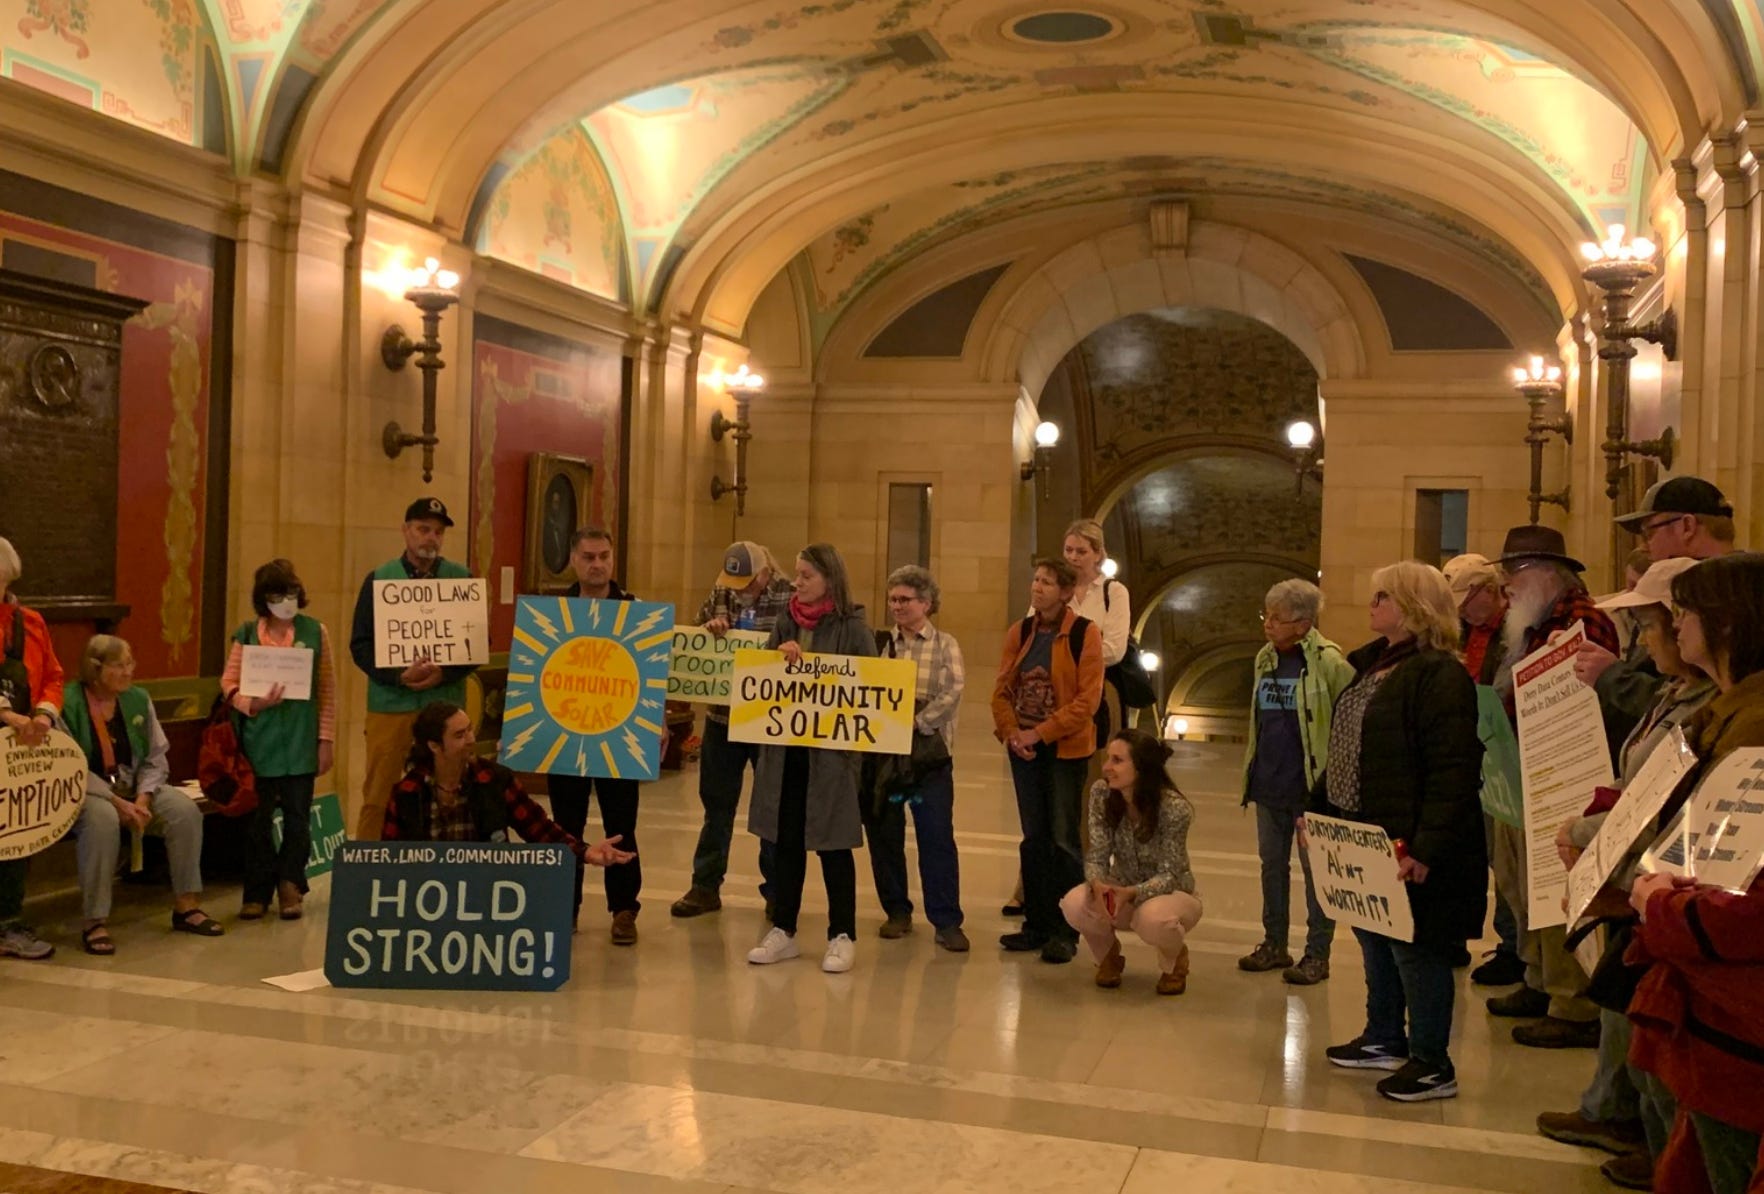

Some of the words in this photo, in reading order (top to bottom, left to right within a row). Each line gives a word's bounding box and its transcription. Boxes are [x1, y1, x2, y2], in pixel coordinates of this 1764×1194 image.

[382, 583, 433, 604] GOOD
[437, 582, 480, 602] LAWS
[420, 605, 435, 614] for
[388, 619, 454, 639] PEOPLE
[672, 632, 707, 651] no
[565, 640, 618, 671] SAVE
[784, 655, 856, 679] Defend
[542, 671, 639, 699] COMMUNITY
[741, 675, 903, 711] COMMUNITY
[552, 697, 618, 730] SOLAR
[766, 706, 876, 743] SOLAR
[8, 761, 53, 777] REVIEW
[446, 848, 563, 866] COMMUNITIES!
[370, 879, 527, 921] HOLD
[1322, 885, 1366, 917] WORTH
[1366, 894, 1392, 927] IT!
[343, 927, 555, 978] STRONG!
